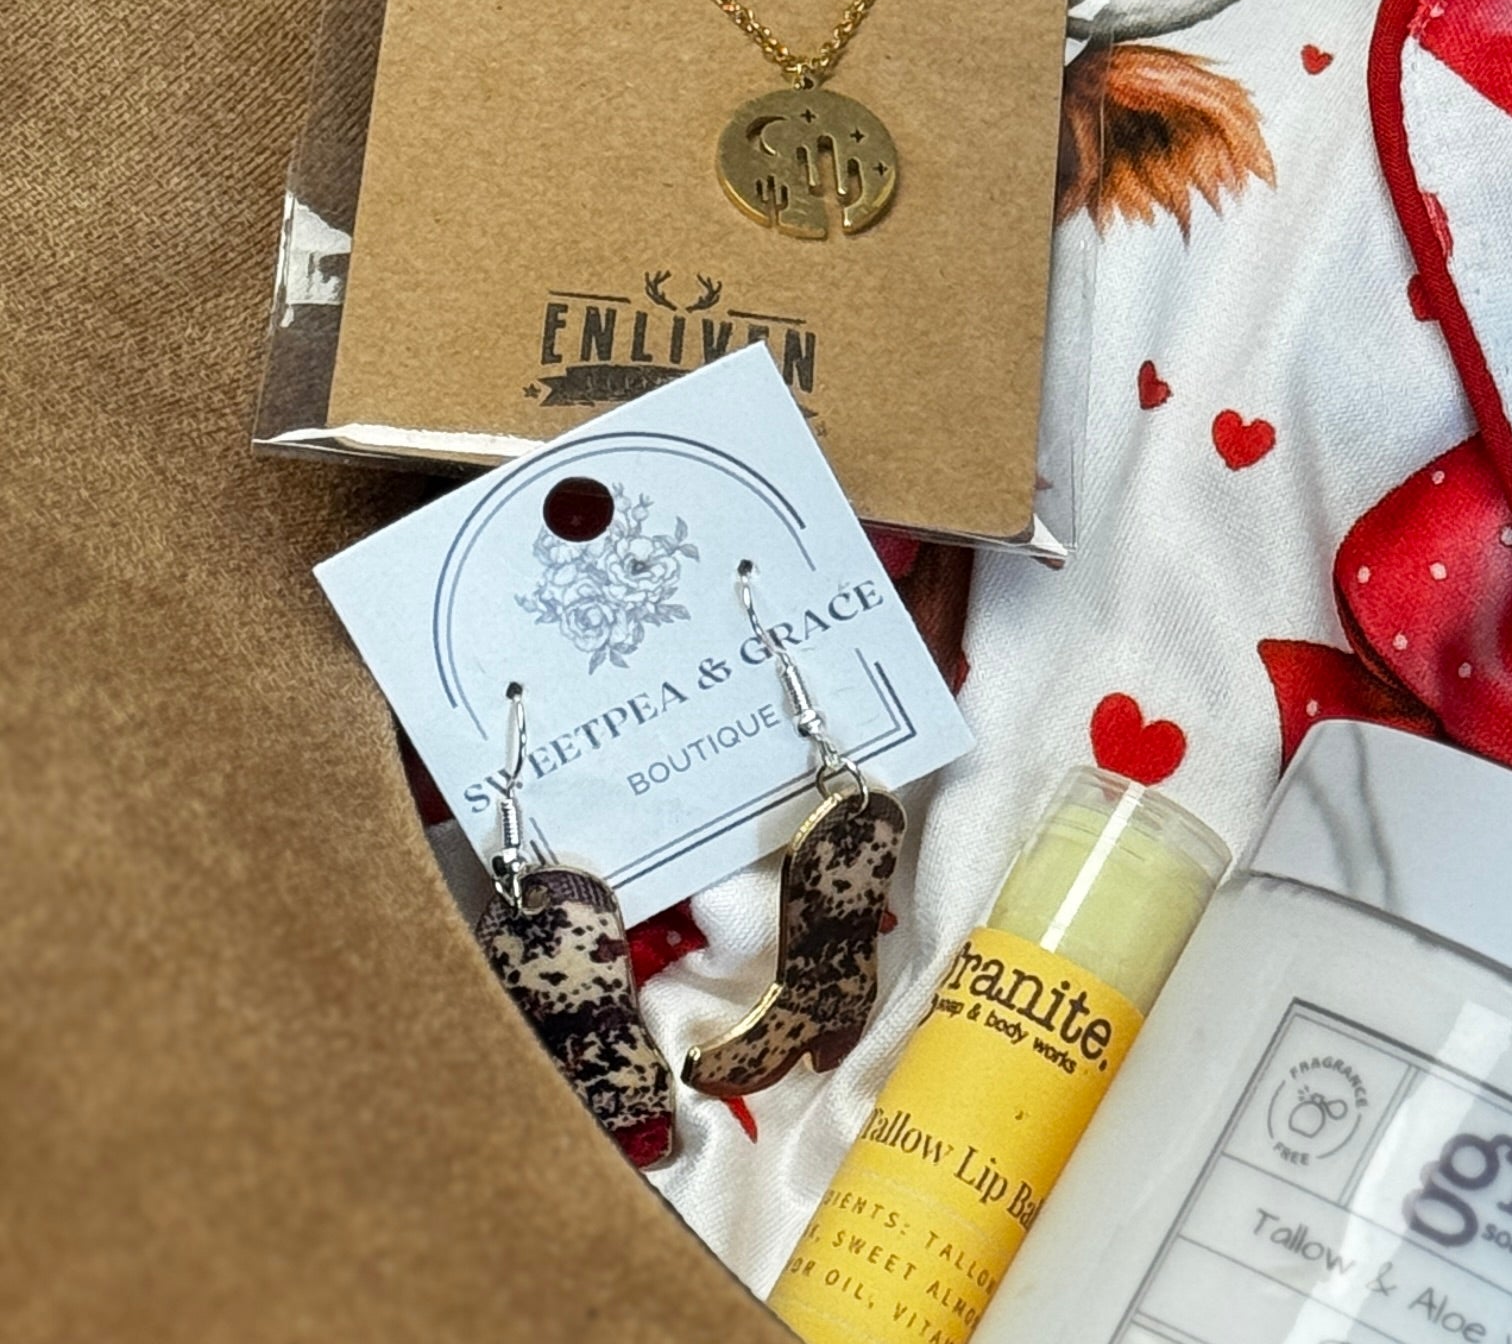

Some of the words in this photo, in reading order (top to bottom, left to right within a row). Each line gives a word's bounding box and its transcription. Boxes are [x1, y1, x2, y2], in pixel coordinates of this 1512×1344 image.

[697, 657, 733, 691] &
[739, 579, 885, 666] GRACE
[626, 703, 781, 796] BOUTIQUE
[966, 1002, 982, 1022] &
[983, 1009, 1030, 1045] body
[1032, 1036, 1078, 1075] works
[1288, 1056, 1369, 1109] FRAGRANCE
[953, 1145, 1009, 1205] Lip
[1272, 1141, 1311, 1166] FREE
[831, 1229, 917, 1281] SWEET
[1253, 1207, 1357, 1277] Tallow
[1366, 1261, 1398, 1299] &
